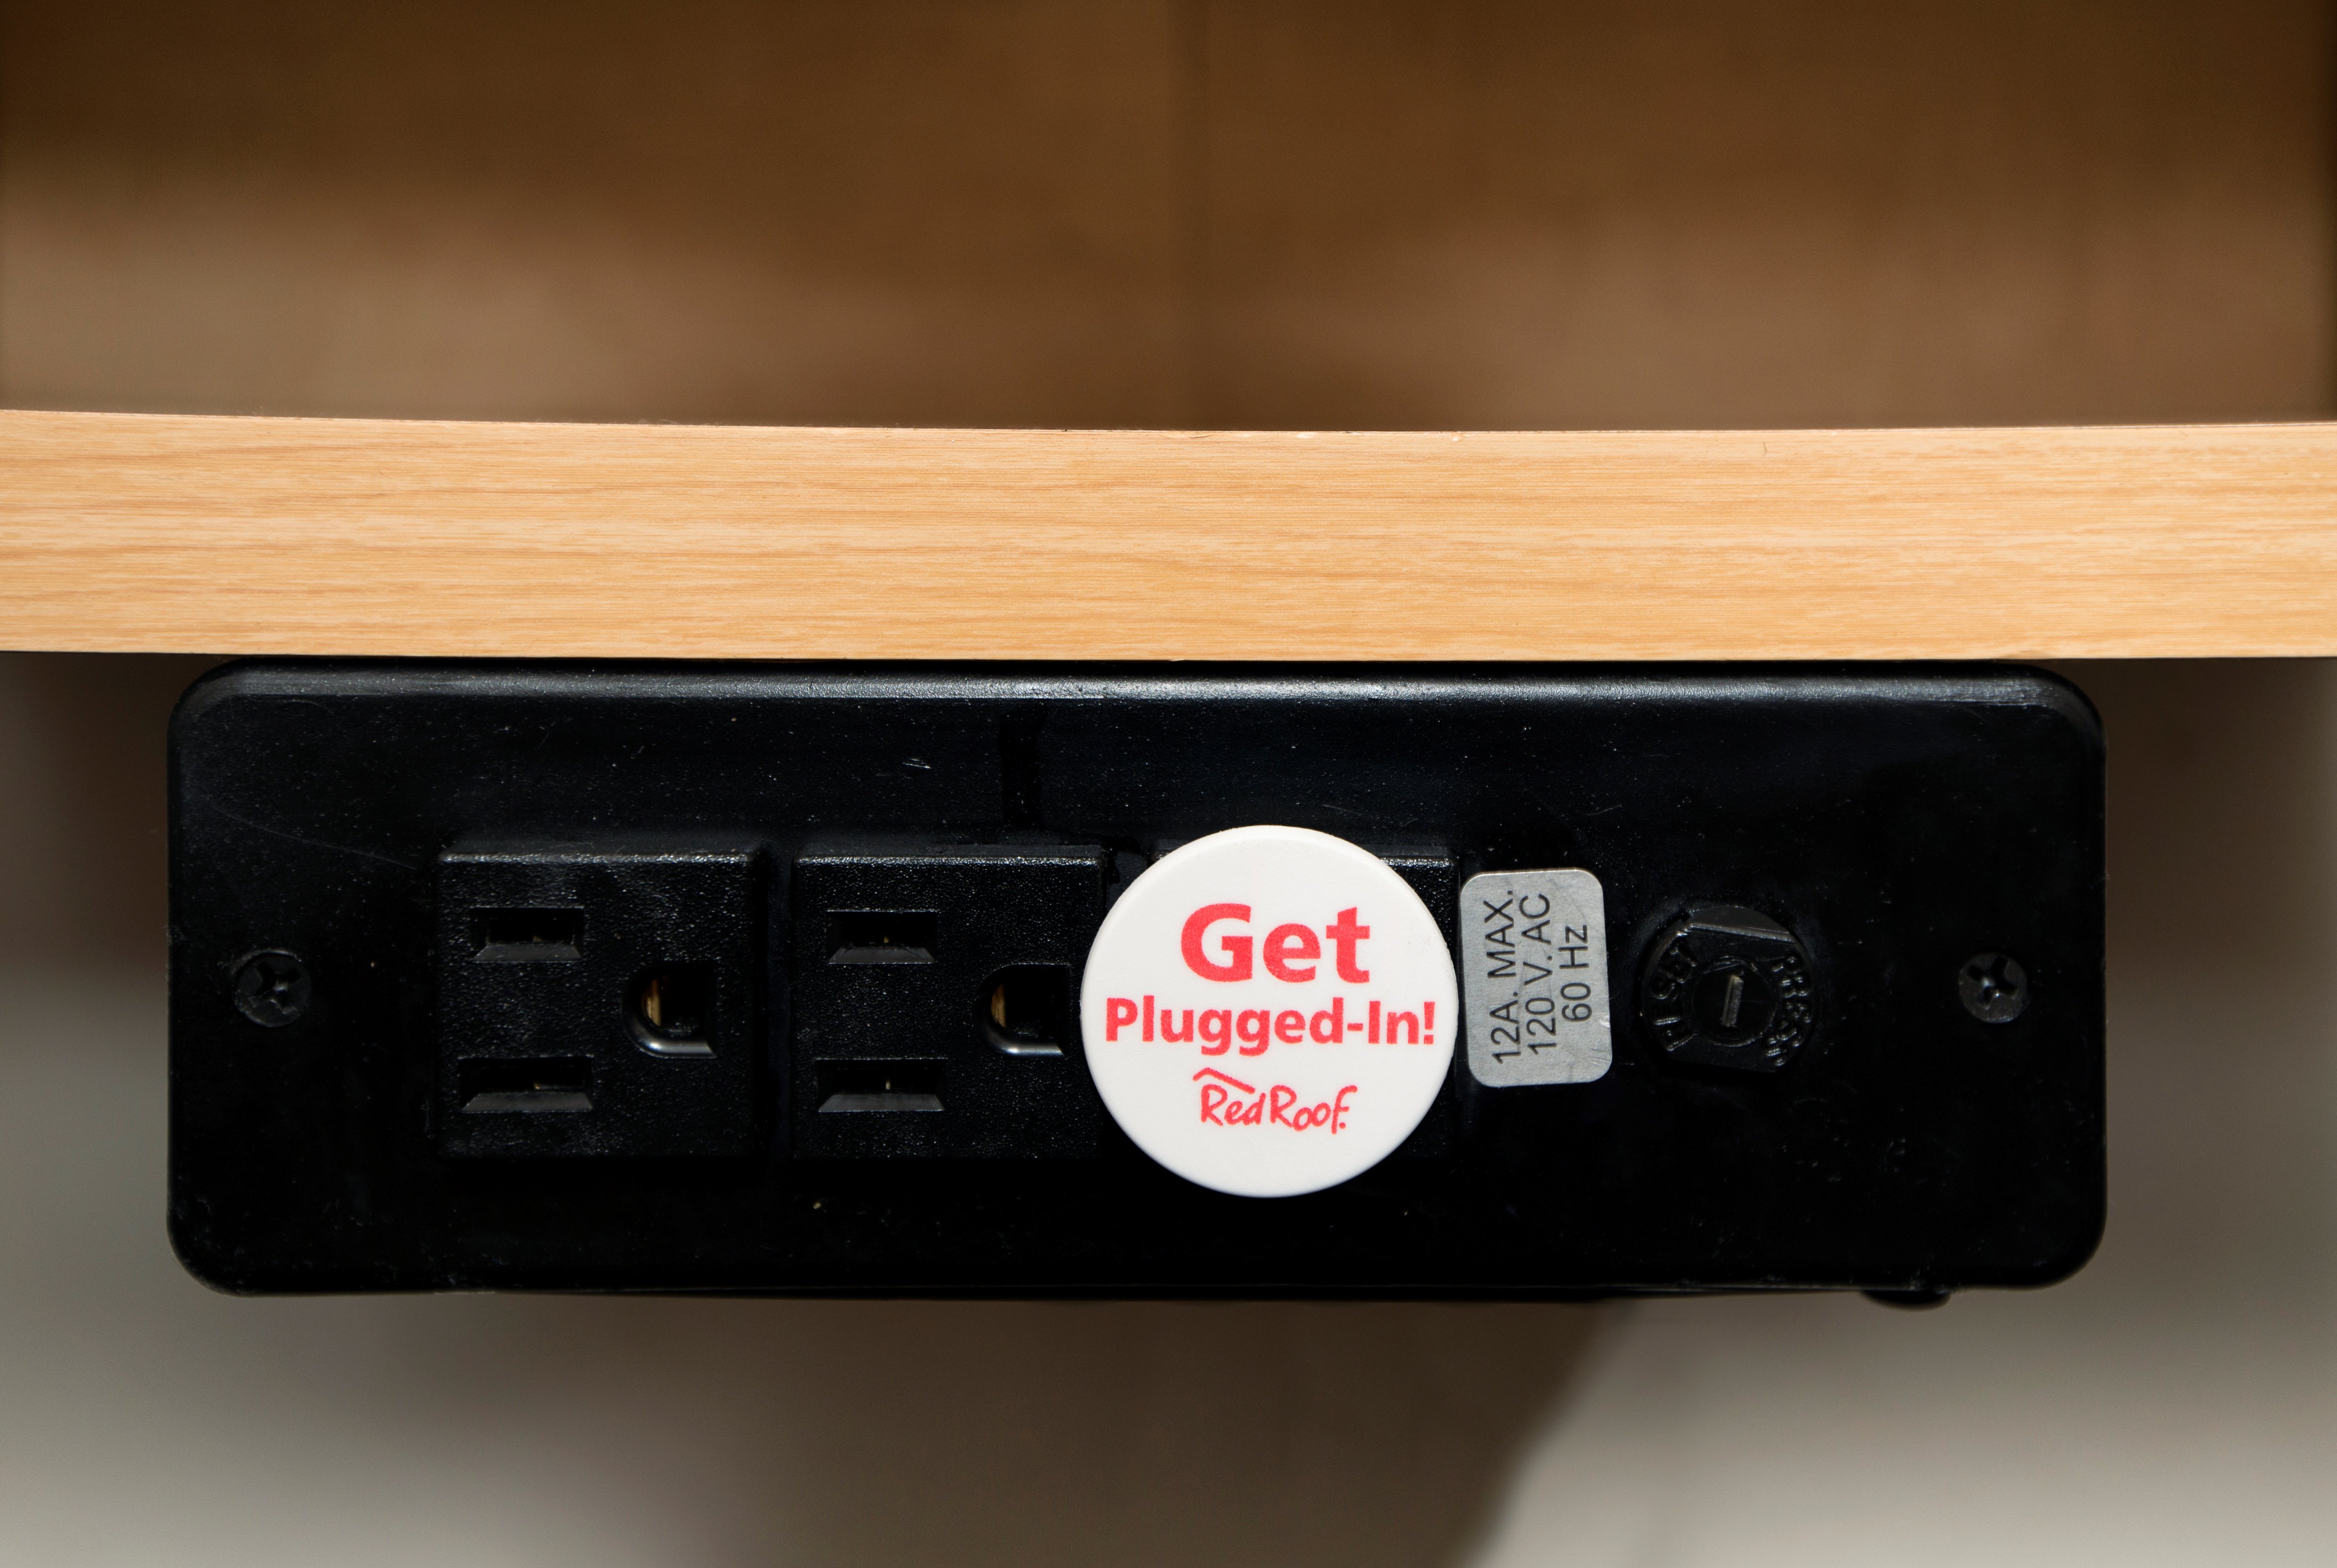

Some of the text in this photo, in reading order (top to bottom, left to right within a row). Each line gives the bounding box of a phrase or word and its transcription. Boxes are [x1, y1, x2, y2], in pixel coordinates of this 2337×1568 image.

[1180, 903, 1370, 984] Get
[1483, 889, 1521, 1064] 12A. MAX.
[1519, 893, 1557, 1055] 120 V. AC
[1557, 924, 1592, 1022] 60 Hz
[1106, 995, 1435, 1057] Plugged-In!
[1650, 944, 1697, 1053] RESET
[1764, 953, 1813, 1068] PRESS
